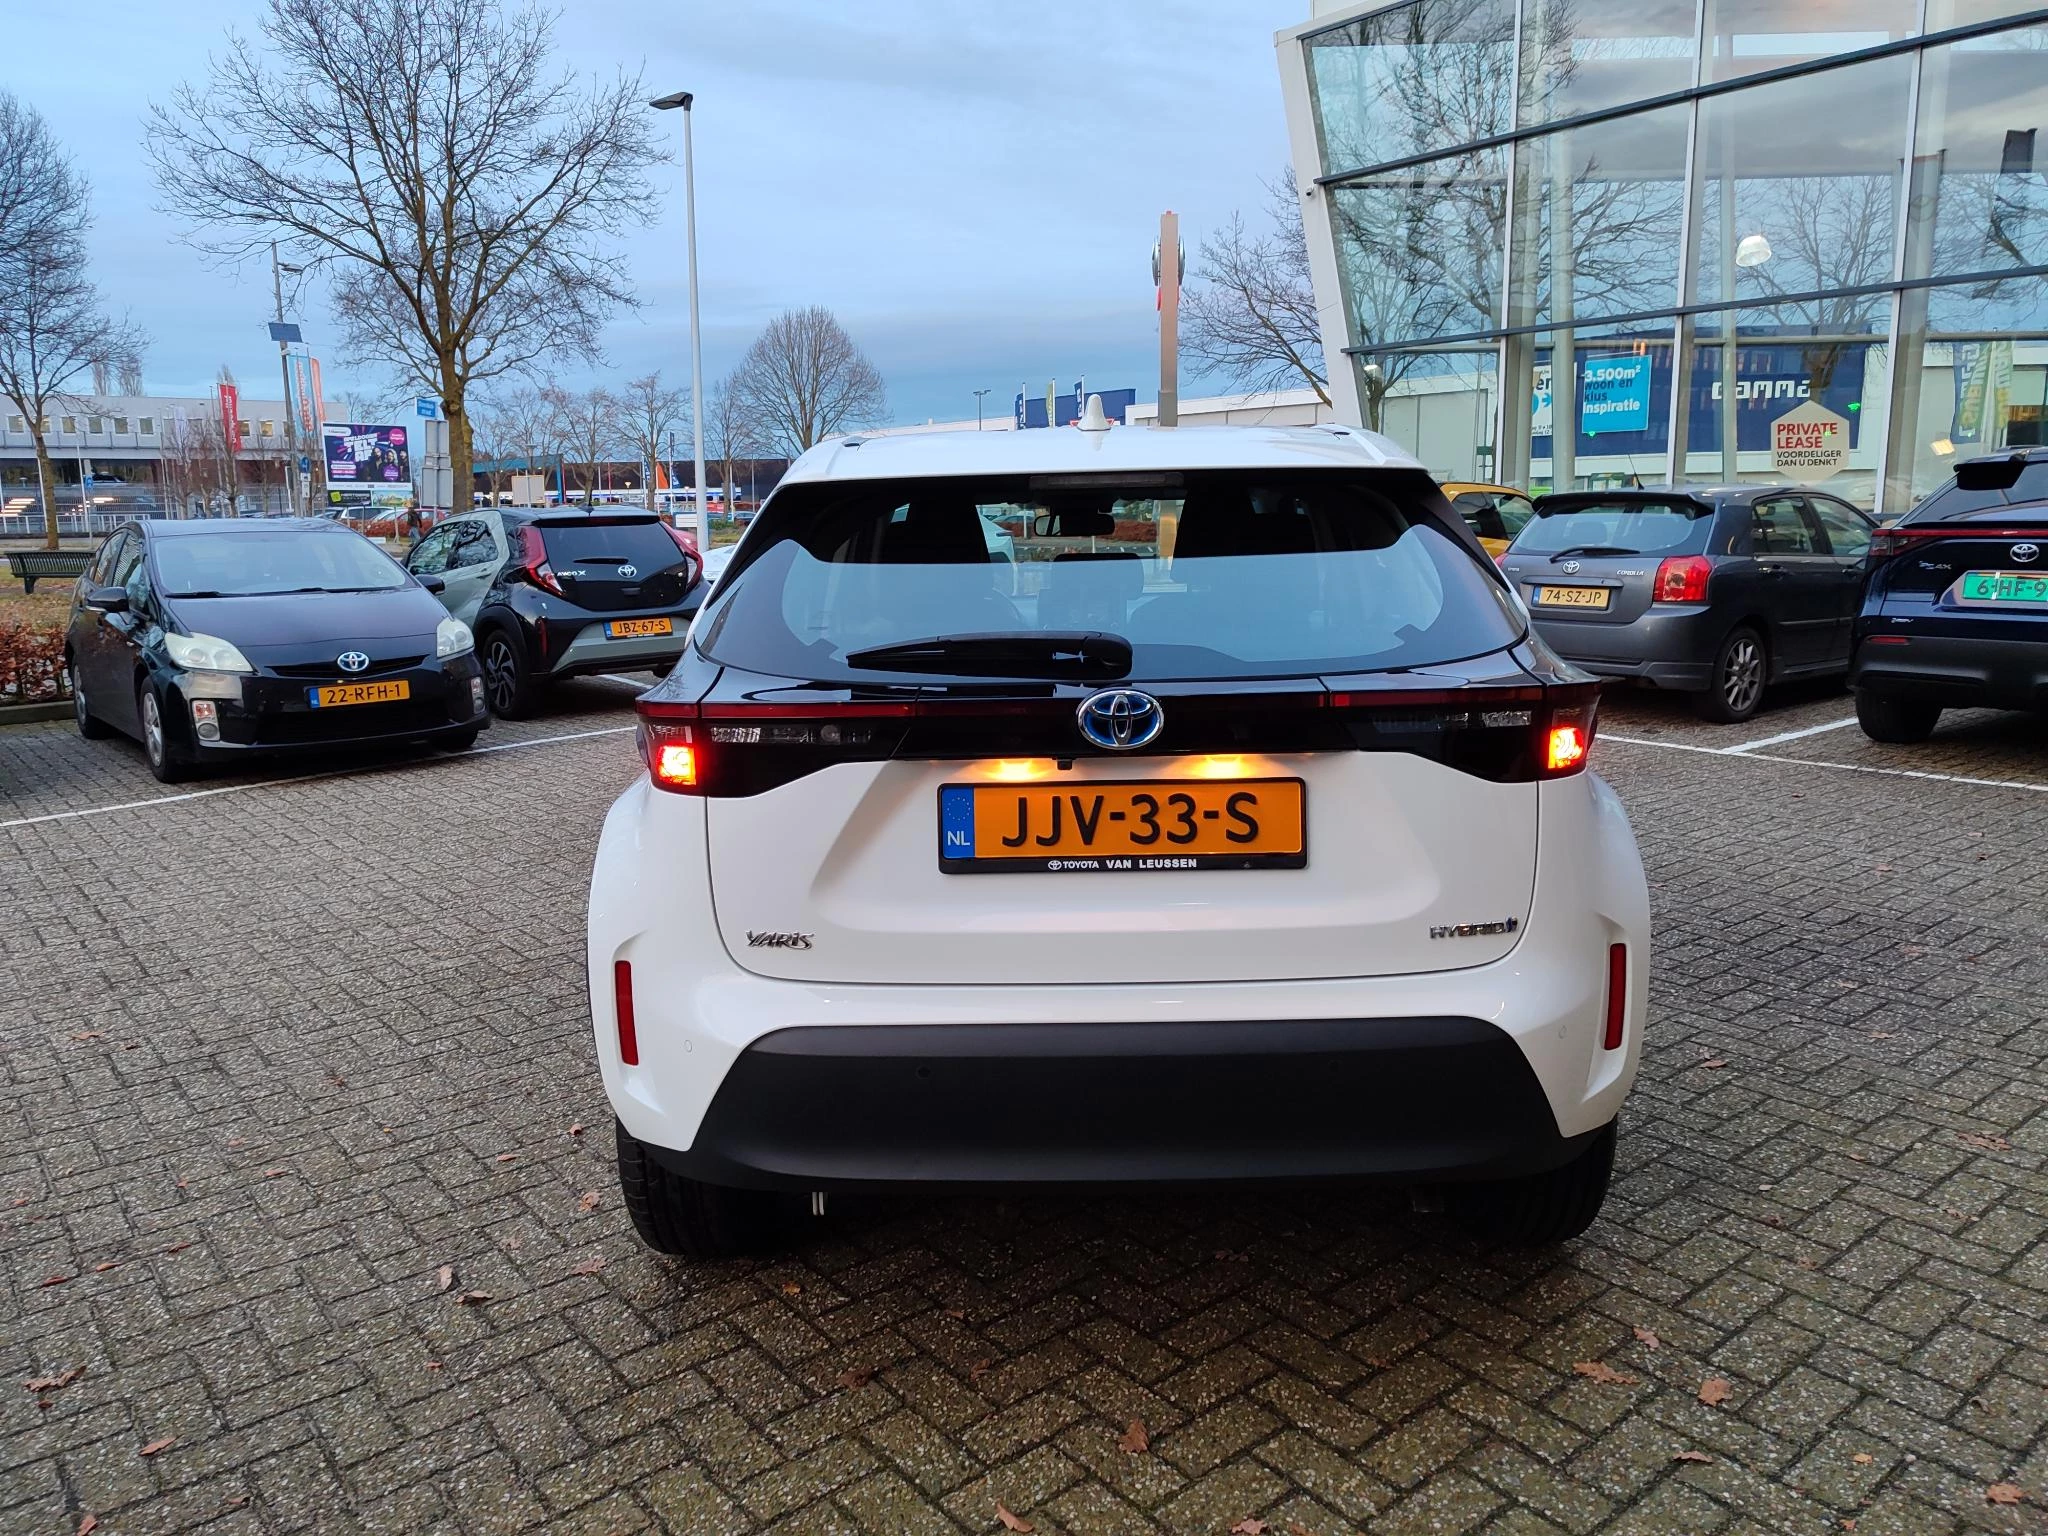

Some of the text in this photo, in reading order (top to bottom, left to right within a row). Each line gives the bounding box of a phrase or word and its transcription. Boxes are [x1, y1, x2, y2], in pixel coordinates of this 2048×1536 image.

[1585, 379, 1632, 390] woon en
[1584, 391, 1607, 402] klus
[1777, 422, 1838, 435] PRIVATE
[1777, 436, 1823, 449] LEASE
[1777, 450, 1841, 459] VOORDELIGER
[1777, 458, 1838, 467] DAN U DENKT
[1546, 589, 1601, 604] 74-SZ-JP
[618, 620, 666, 634] JBZ-67-S
[327, 683, 400, 704] 22-RFH-1
[947, 791, 1259, 848] NL JJV-33-S
[1063, 857, 1198, 870] TOYOTA VAN LEUSSEN
[1429, 921, 1505, 939] HYBRID
